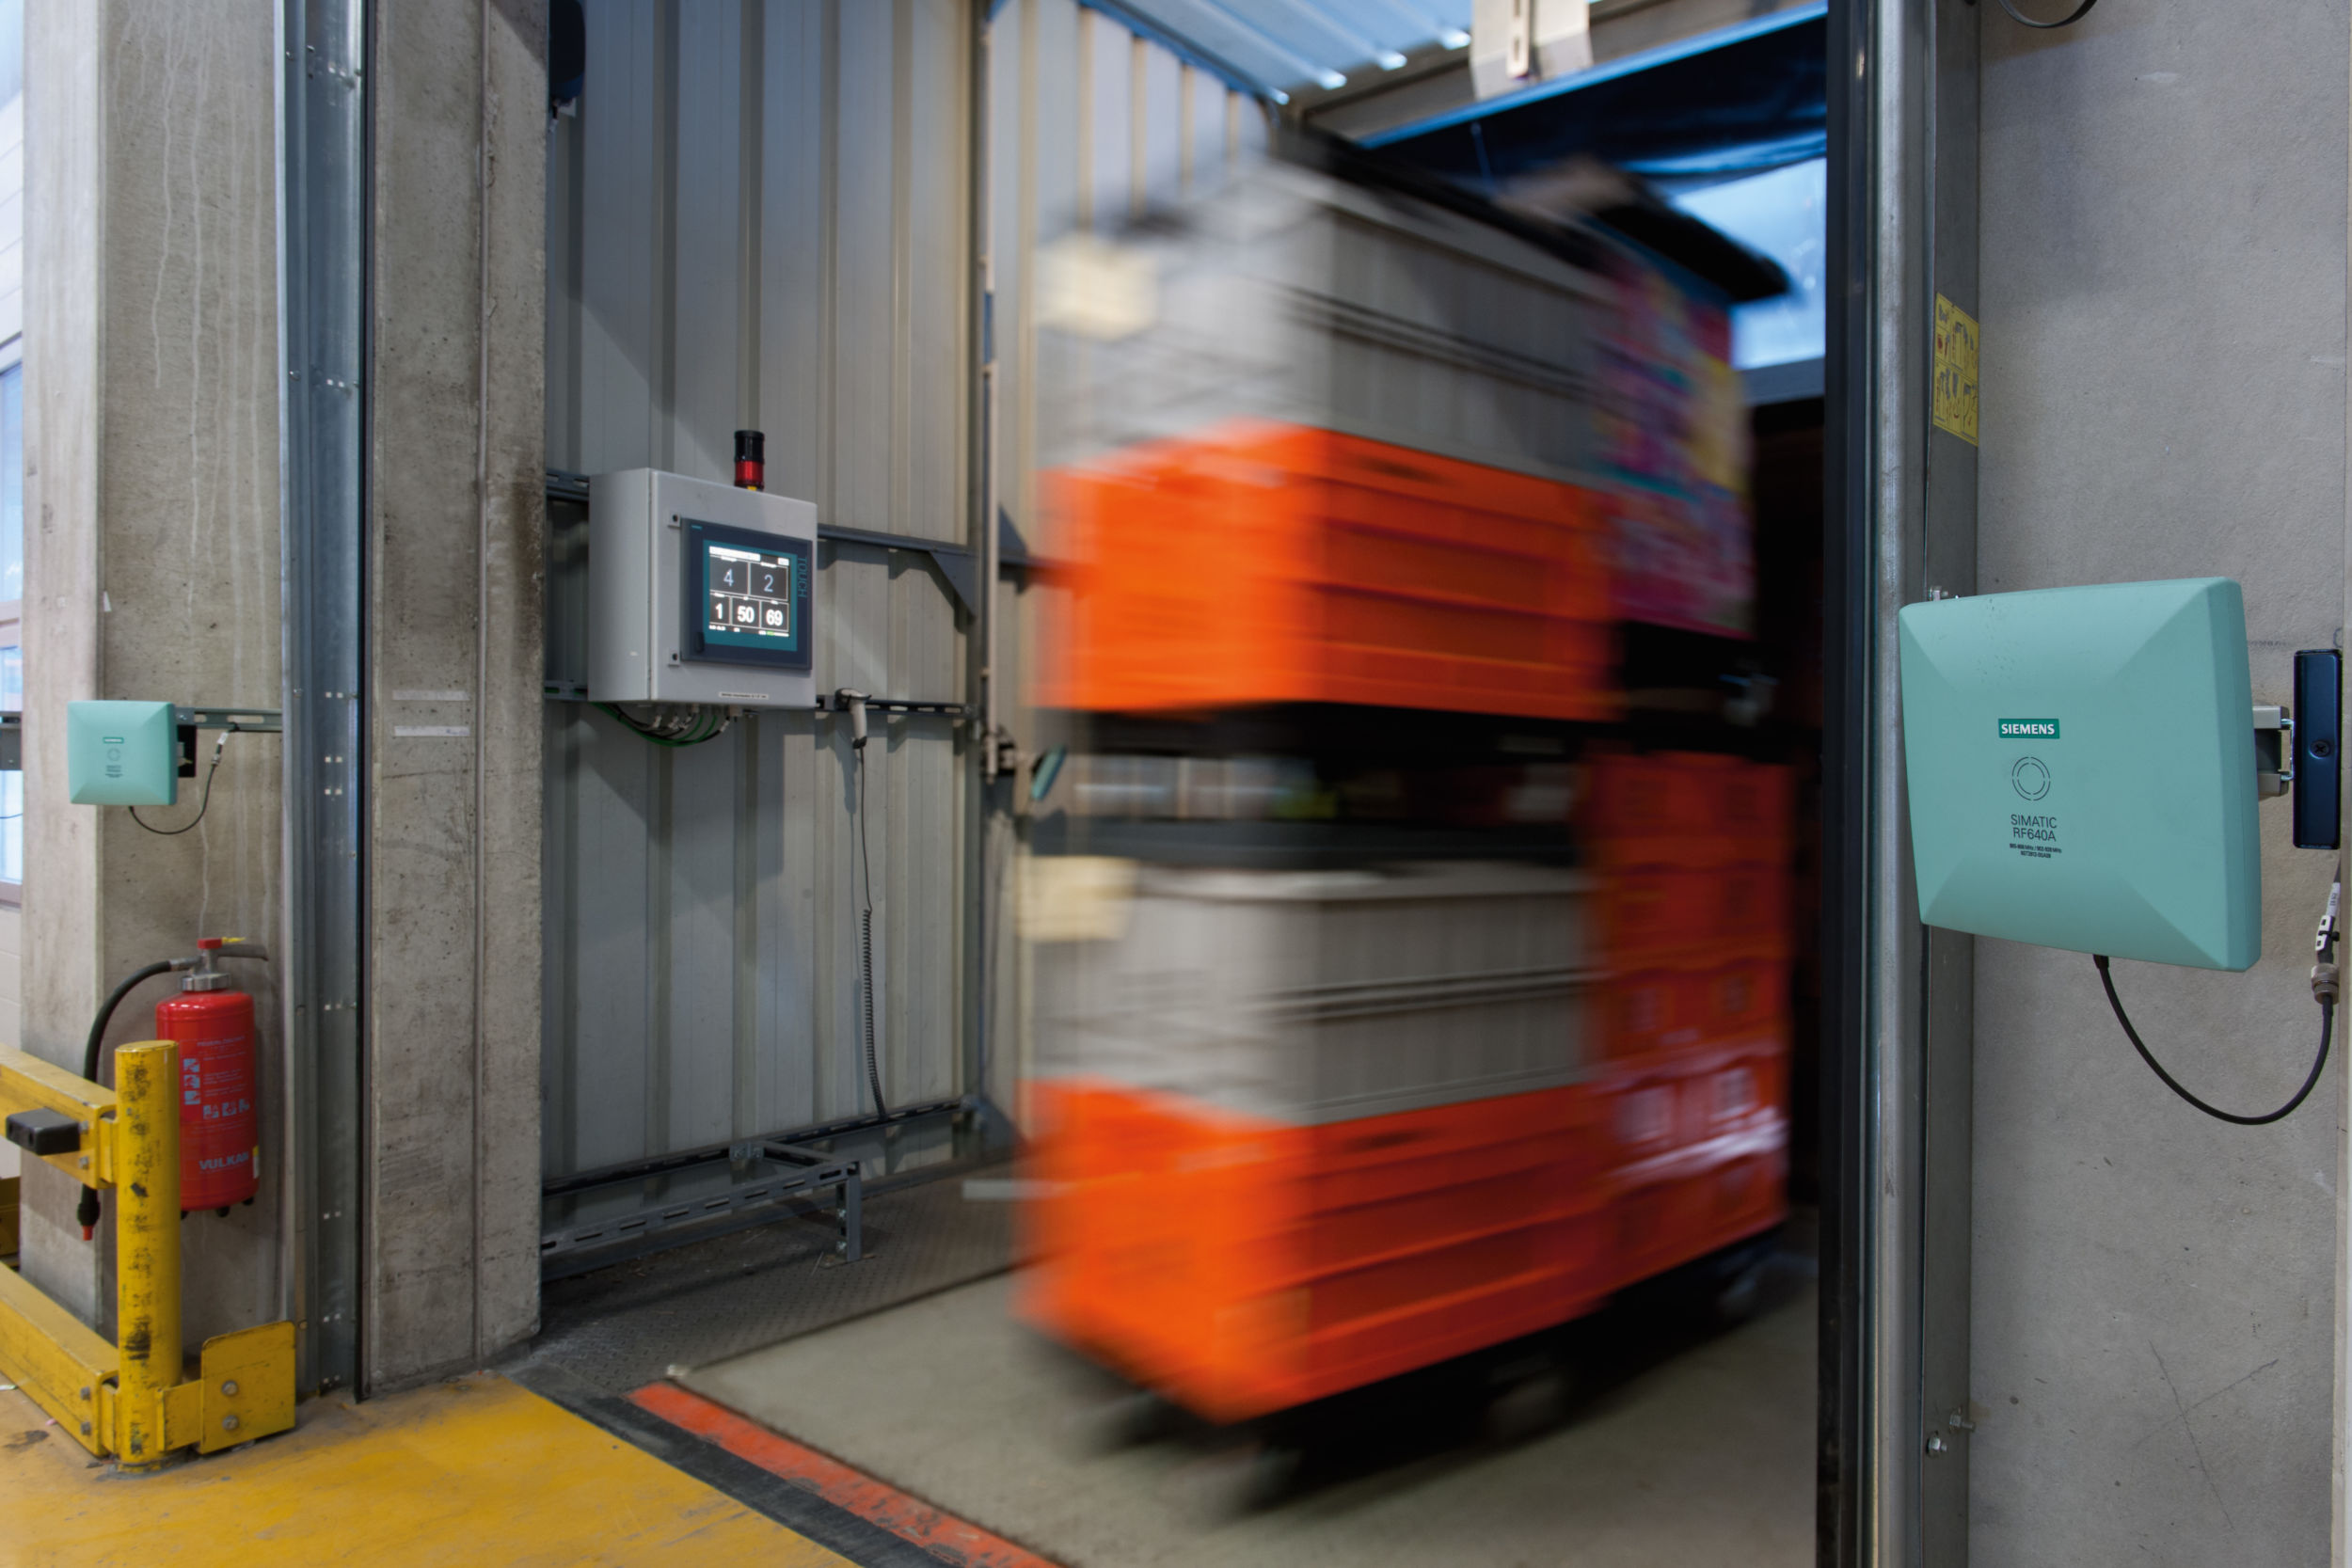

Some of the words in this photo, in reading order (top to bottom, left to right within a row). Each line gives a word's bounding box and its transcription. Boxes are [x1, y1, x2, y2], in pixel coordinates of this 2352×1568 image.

[723, 568, 734, 587] 4
[764, 574, 774, 593] 2
[798, 557, 807, 598] TOUCH
[715, 602, 723, 620] 1
[737, 605, 755, 624] 50
[766, 609, 784, 626] 69
[2001, 723, 2055, 735] SIEMENS
[2010, 814, 2058, 829] SIMATIC
[2013, 827, 2057, 842] RF640A
